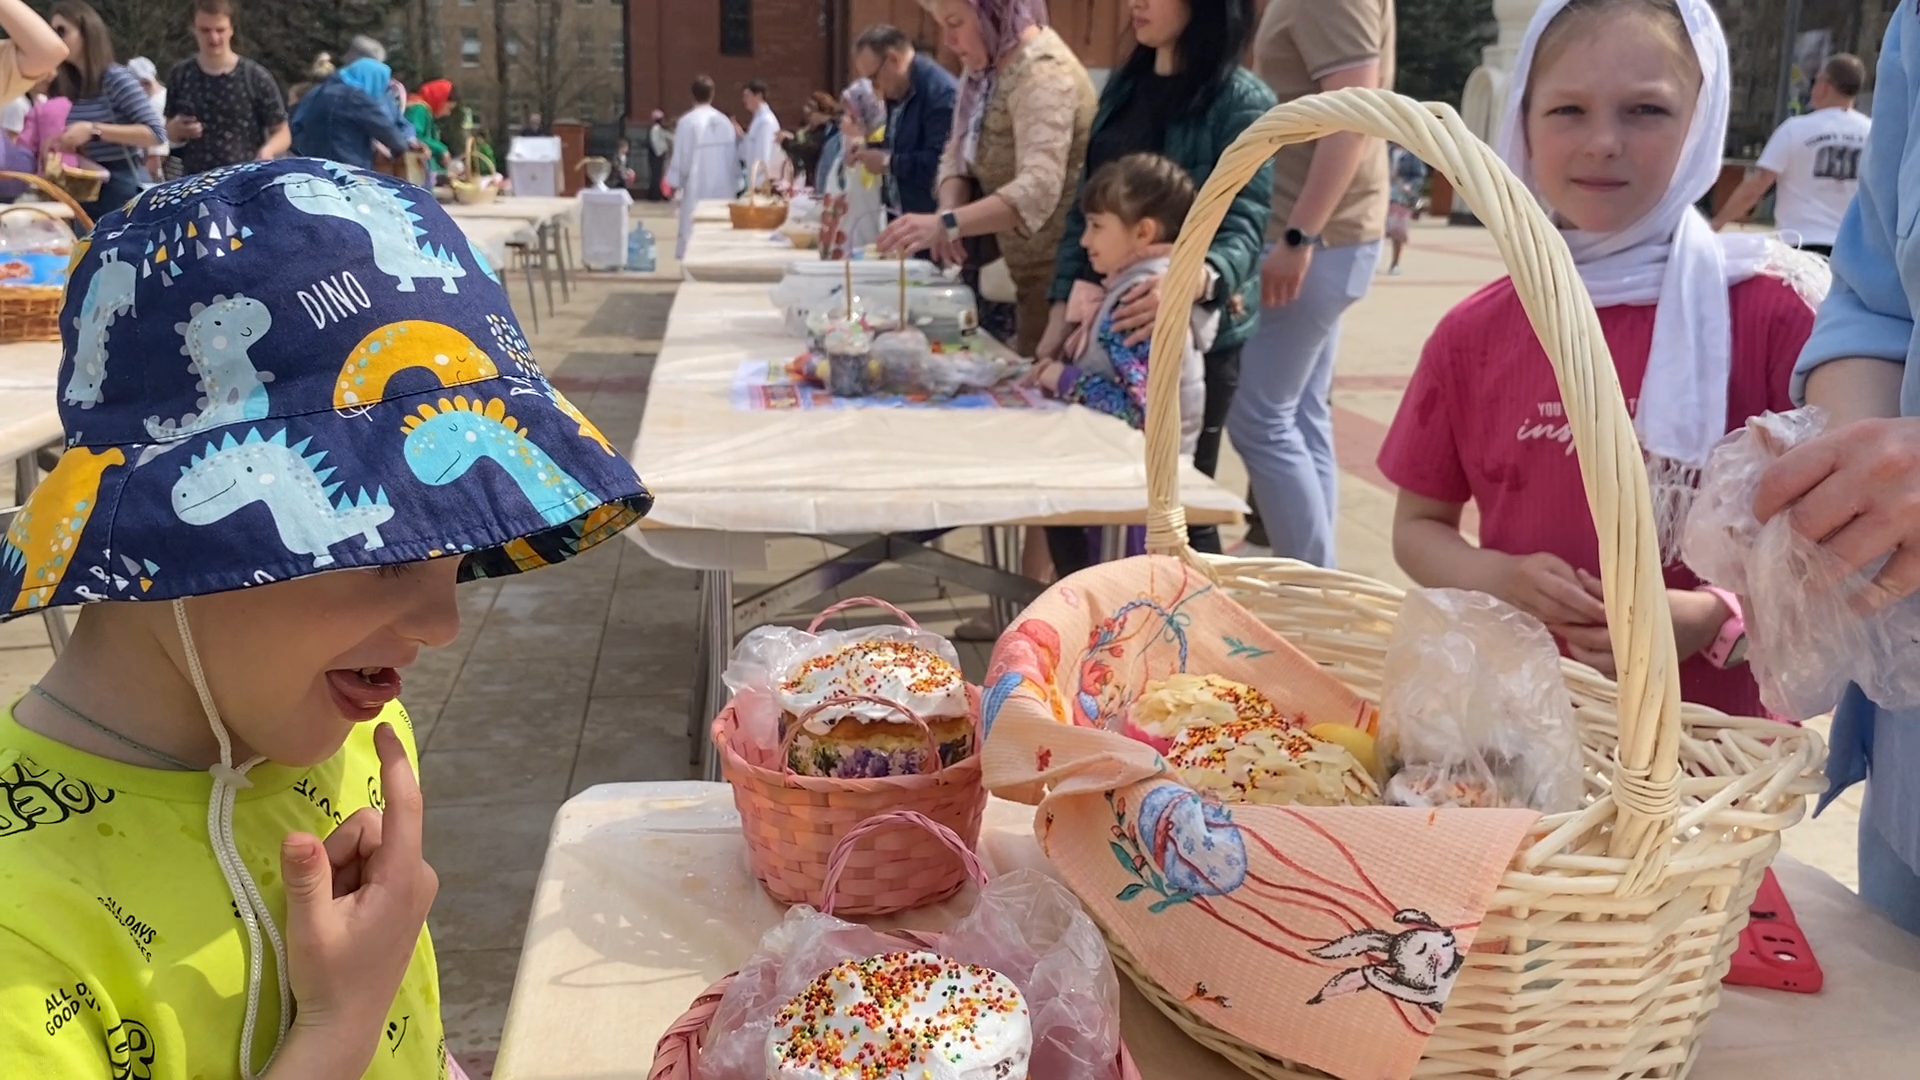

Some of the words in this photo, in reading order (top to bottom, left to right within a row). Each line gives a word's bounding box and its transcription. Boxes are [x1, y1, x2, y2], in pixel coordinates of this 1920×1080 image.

[296, 270, 372, 330] DINO
[124, 914, 157, 945] DAYS
[45, 987, 73, 1015] ALL
[45, 999, 80, 1037] GOOD
